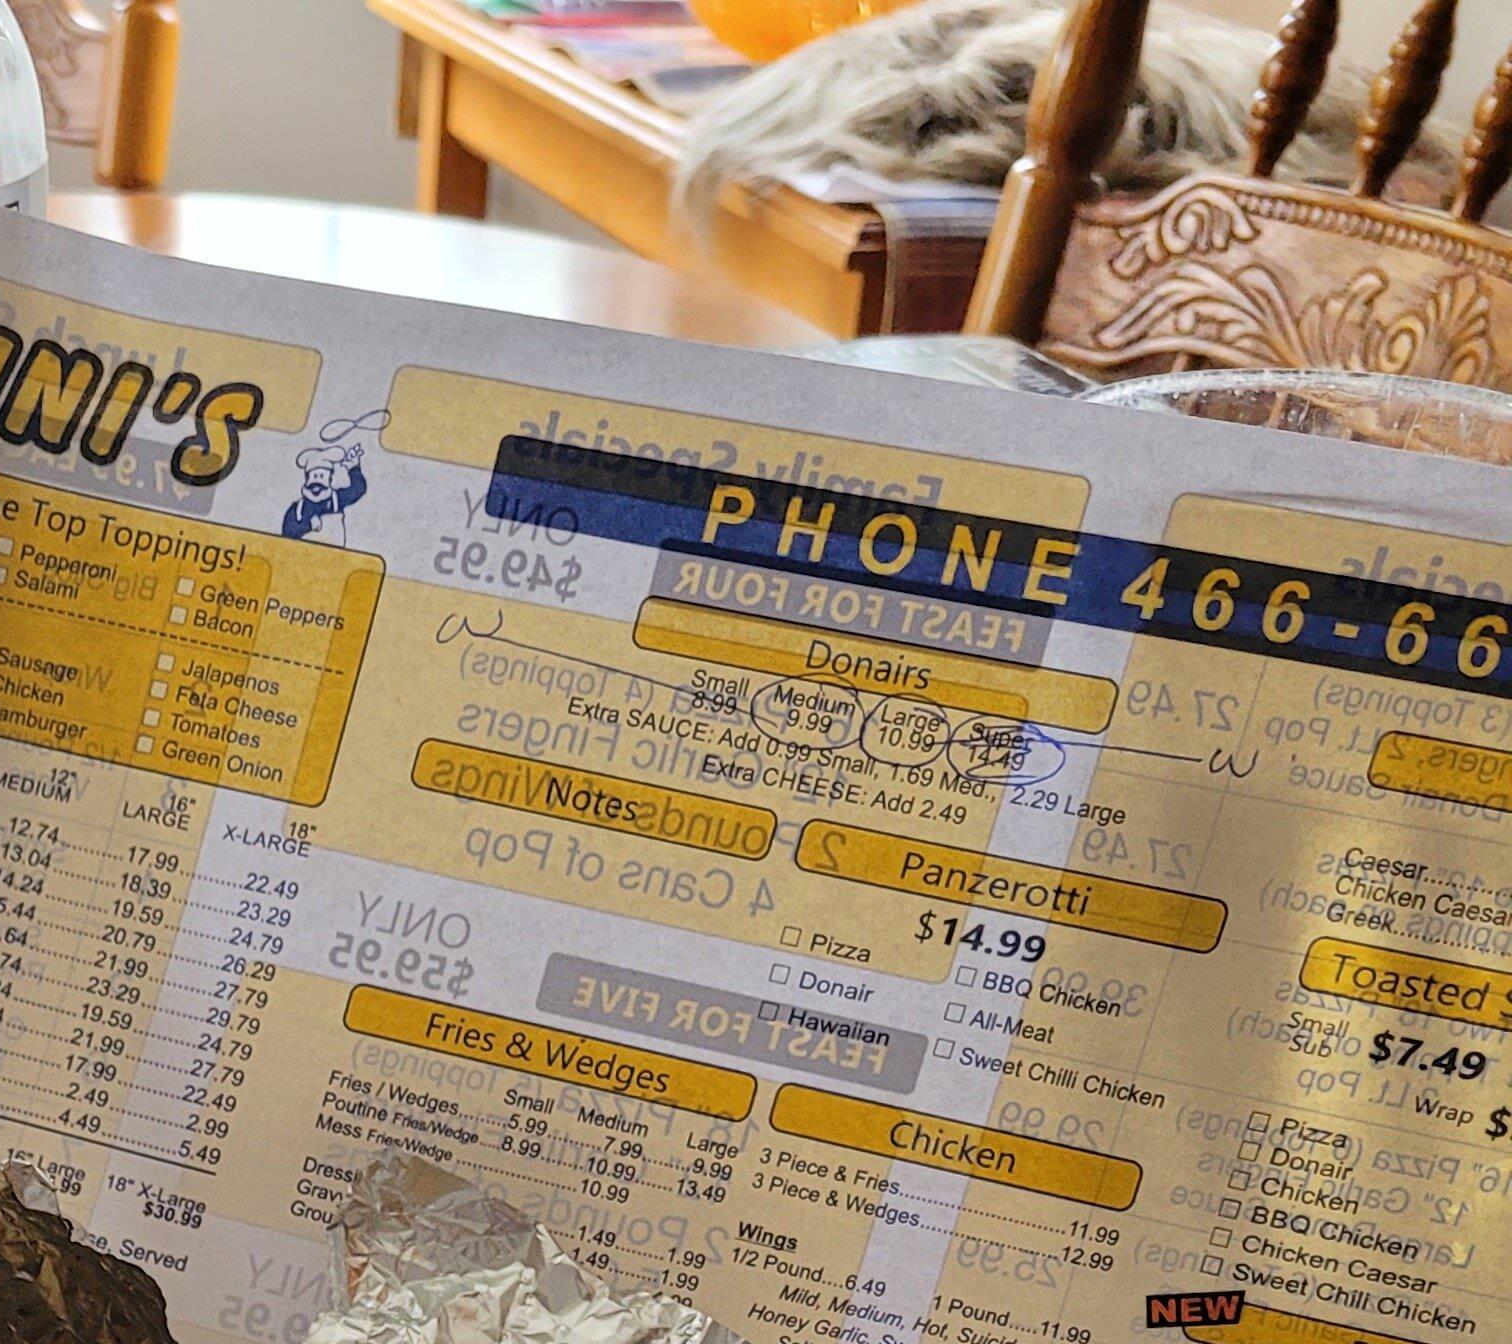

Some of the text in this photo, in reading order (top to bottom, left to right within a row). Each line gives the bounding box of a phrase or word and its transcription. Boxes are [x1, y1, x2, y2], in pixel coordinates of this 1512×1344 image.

[32, 497, 87, 543] Top
[97, 515, 246, 573] Toppings!
[20, 545, 117, 584] Pepperoni
[701, 485, 1508, 679] PHONE 466-66
[193, 609, 254, 638] Bacon
[199, 584, 346, 631] Green Peppers
[181, 660, 279, 696] Jalapenos
[805, 638, 932, 690] Donairs
[175, 687, 298, 729] Feta Cheese
[690, 669, 942, 733] Small Medium Large
[691, 692, 737, 716] 8.99
[170, 714, 261, 749] Tomatoes
[567, 696, 1127, 826] Extra SAUCE: Add 0.99 2.29 Large
[546, 776, 640, 822] Notes
[762, 767, 868, 806] CHEESE:
[122, 801, 191, 831] LARGE
[8, 817, 60, 843] 12.74
[127, 847, 179, 873] 17.99
[243, 873, 300, 899] 22.49
[222, 823, 312, 859] X-LARGE
[1344, 846, 1428, 881] Caesar
[899, 851, 1094, 917] Panzerotti
[1334, 873, 1427, 912] Chicken
[236, 901, 292, 927] 23.29
[913, 909, 1047, 964] $14.99
[1326, 901, 1394, 934] Greek
[809, 932, 1122, 1019] Pizza BBQ Chicken
[1332, 952, 1492, 1012] Toasted
[969, 1009, 1055, 1045] All-Meat
[425, 1012, 671, 1095] Fries Wedges
[787, 1006, 1167, 1110] Hawaiian Sweet Chilli Chicken
[1368, 1030, 1488, 1081] $7.49
[321, 1092, 479, 1146] Poutine Fries/Wedge
[328, 1071, 374, 1096] Fries
[508, 1113, 548, 1137] 5.99
[503, 1088, 739, 1160] Small Medium Large
[1415, 1095, 1475, 1127] Wrap
[58, 1108, 101, 1135] 4.49
[177, 1139, 222, 1166] 5.49
[889, 1118, 1017, 1174] Chicken
[1269, 1147, 1356, 1181] Donair
[137, 1182, 207, 1215] X-Large
[142, 1202, 204, 1229] $30.99
[776, 1151, 1120, 1247] Piece Fries 11.99
[1260, 1176, 1360, 1216] Chicken
[737, 1221, 798, 1257] Wings
[1251, 1205, 1420, 1260] BBQ Chicken
[119, 1238, 189, 1273] Served
[763, 1254, 887, 1298] Pound 6.49
[1241, 1233, 1438, 1294] Chicken Caesar
[748, 1302, 810, 1335] Honey
[779, 1285, 820, 1313] Mild,
[827, 1299, 905, 1331] Medium,
[912, 1317, 949, 1343] Hot,
[1150, 1295, 1240, 1324] NEW
